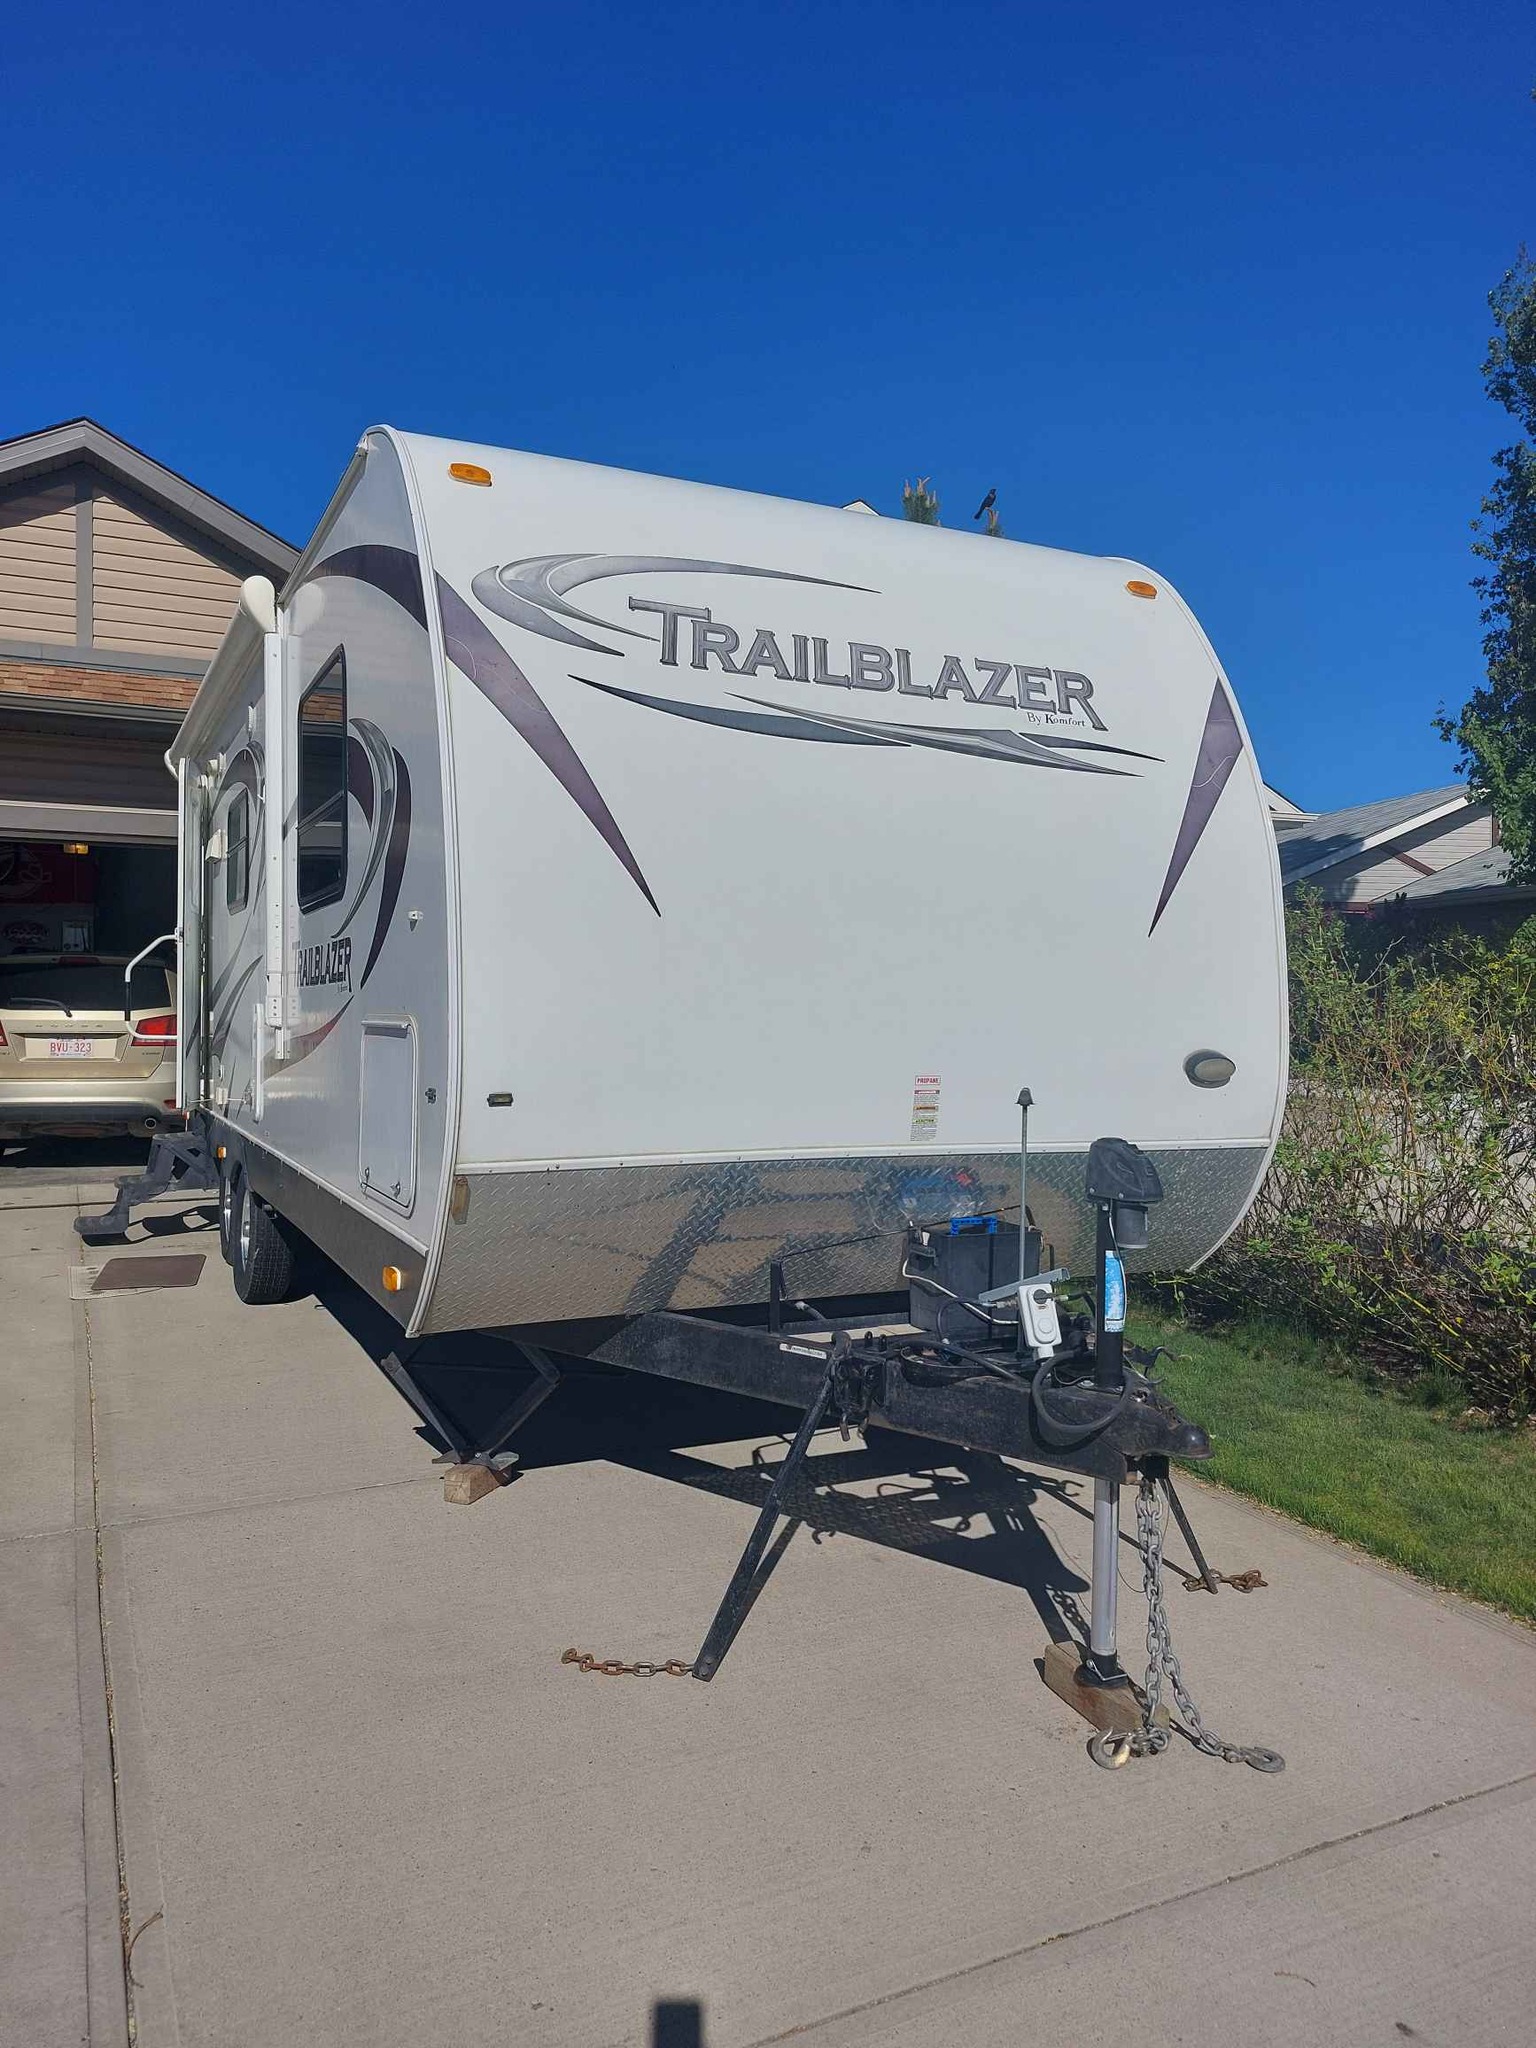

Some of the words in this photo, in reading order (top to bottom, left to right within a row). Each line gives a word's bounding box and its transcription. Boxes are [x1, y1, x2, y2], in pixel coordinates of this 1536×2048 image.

[628, 596, 1109, 732] TRAILBLAZER
[1027, 711, 1041, 726] By
[1045, 713, 1085, 727] Komfort
[293, 936, 353, 993] RAILBLAZER
